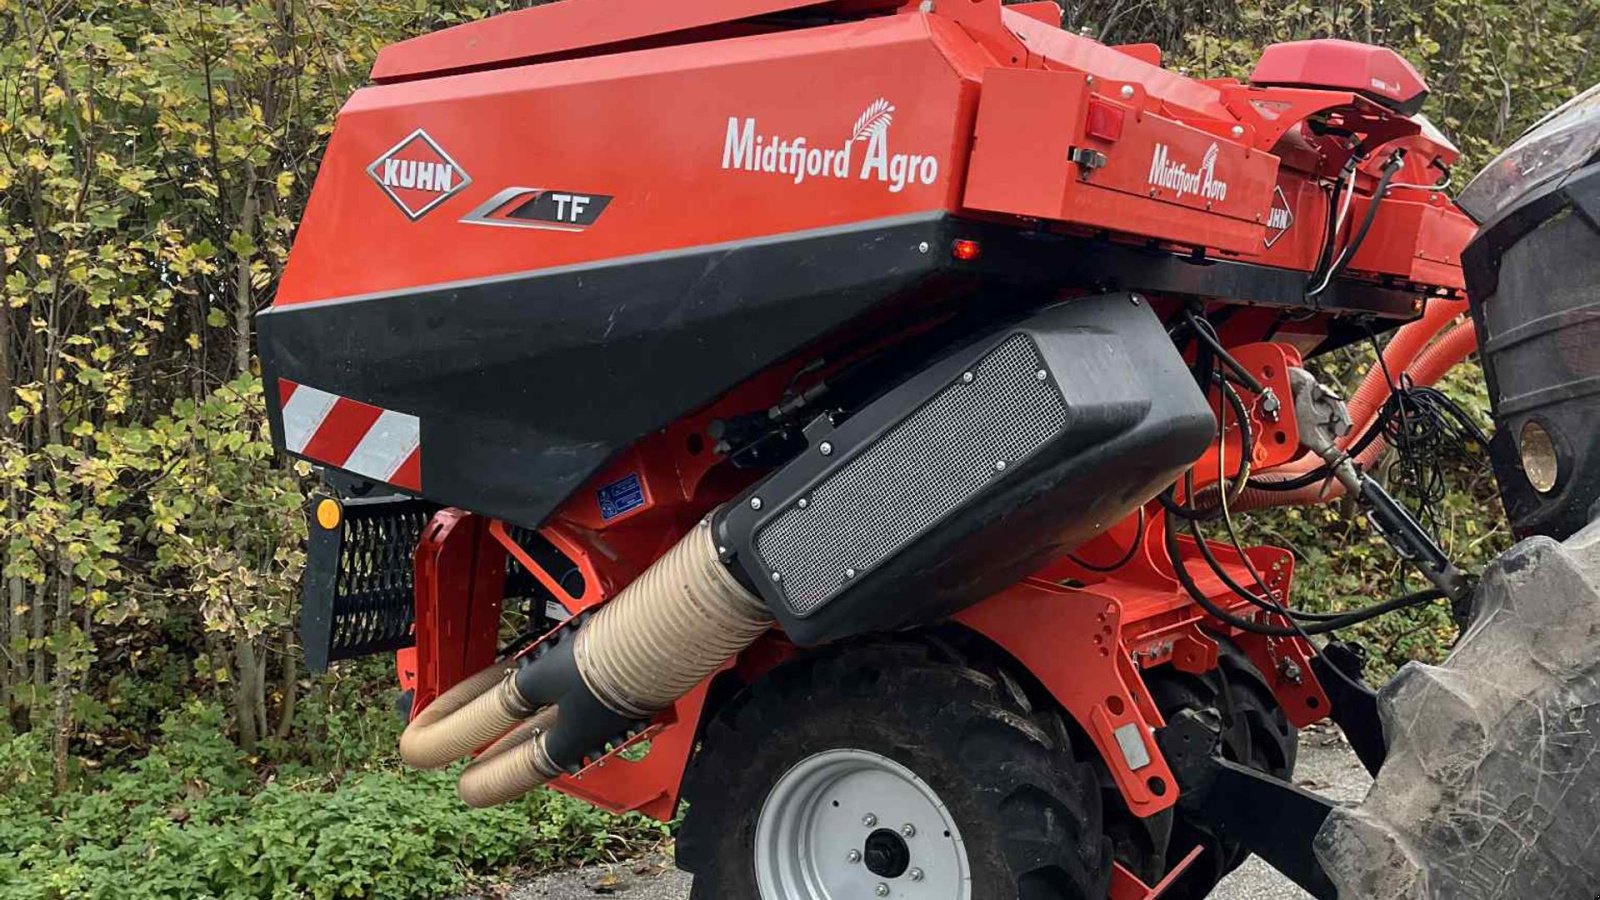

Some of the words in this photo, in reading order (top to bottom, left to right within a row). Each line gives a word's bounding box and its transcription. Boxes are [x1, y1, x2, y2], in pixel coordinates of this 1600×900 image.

[384, 158, 453, 192] KUHN
[722, 116, 852, 184] Midtfjord
[860, 118, 938, 192] Agro
[1148, 143, 1202, 198] Midtfjord
[552, 194, 590, 222] TF
